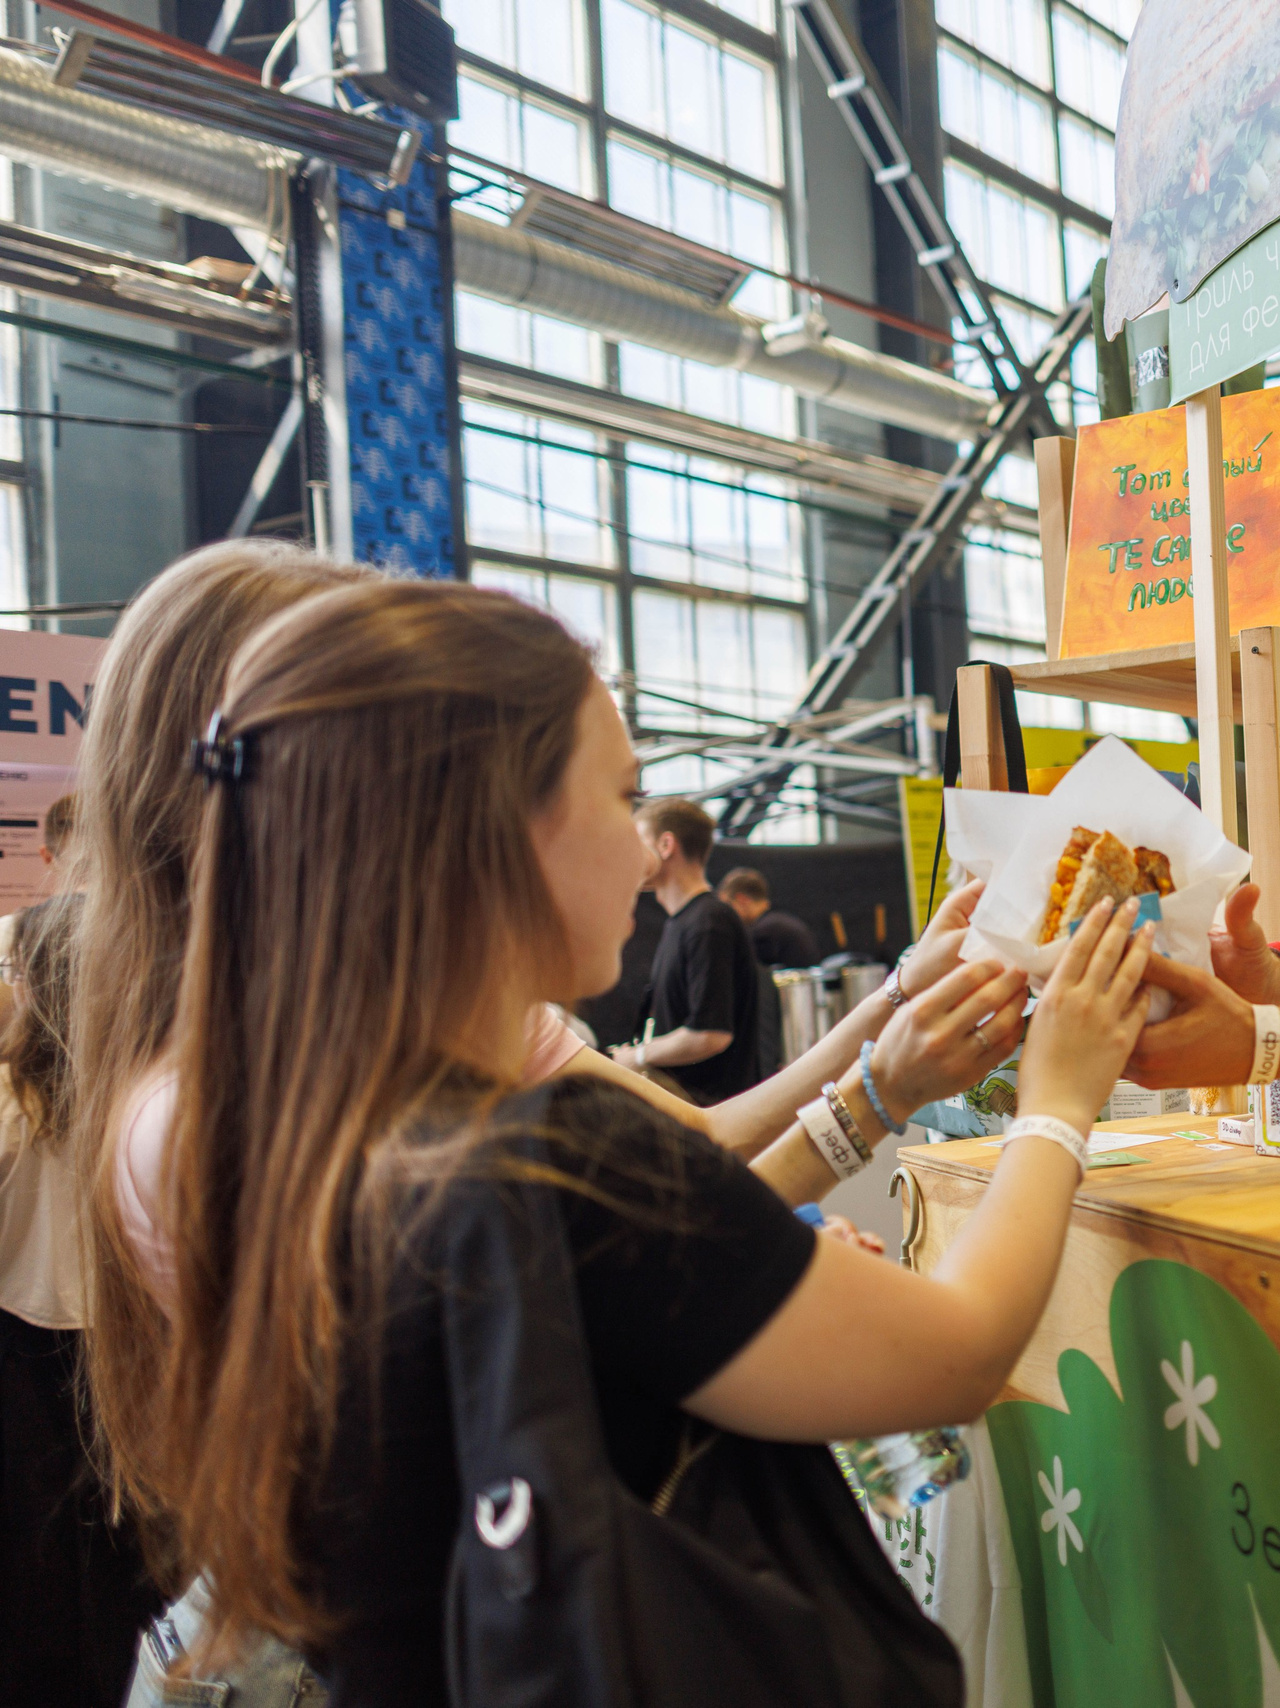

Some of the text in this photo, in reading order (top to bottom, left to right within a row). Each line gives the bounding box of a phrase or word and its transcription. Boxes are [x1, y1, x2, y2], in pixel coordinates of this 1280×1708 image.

[1189, 322, 1231, 381] для
[1112, 463, 1171, 497] Тот
[1098, 537, 1144, 574] ТЕ
